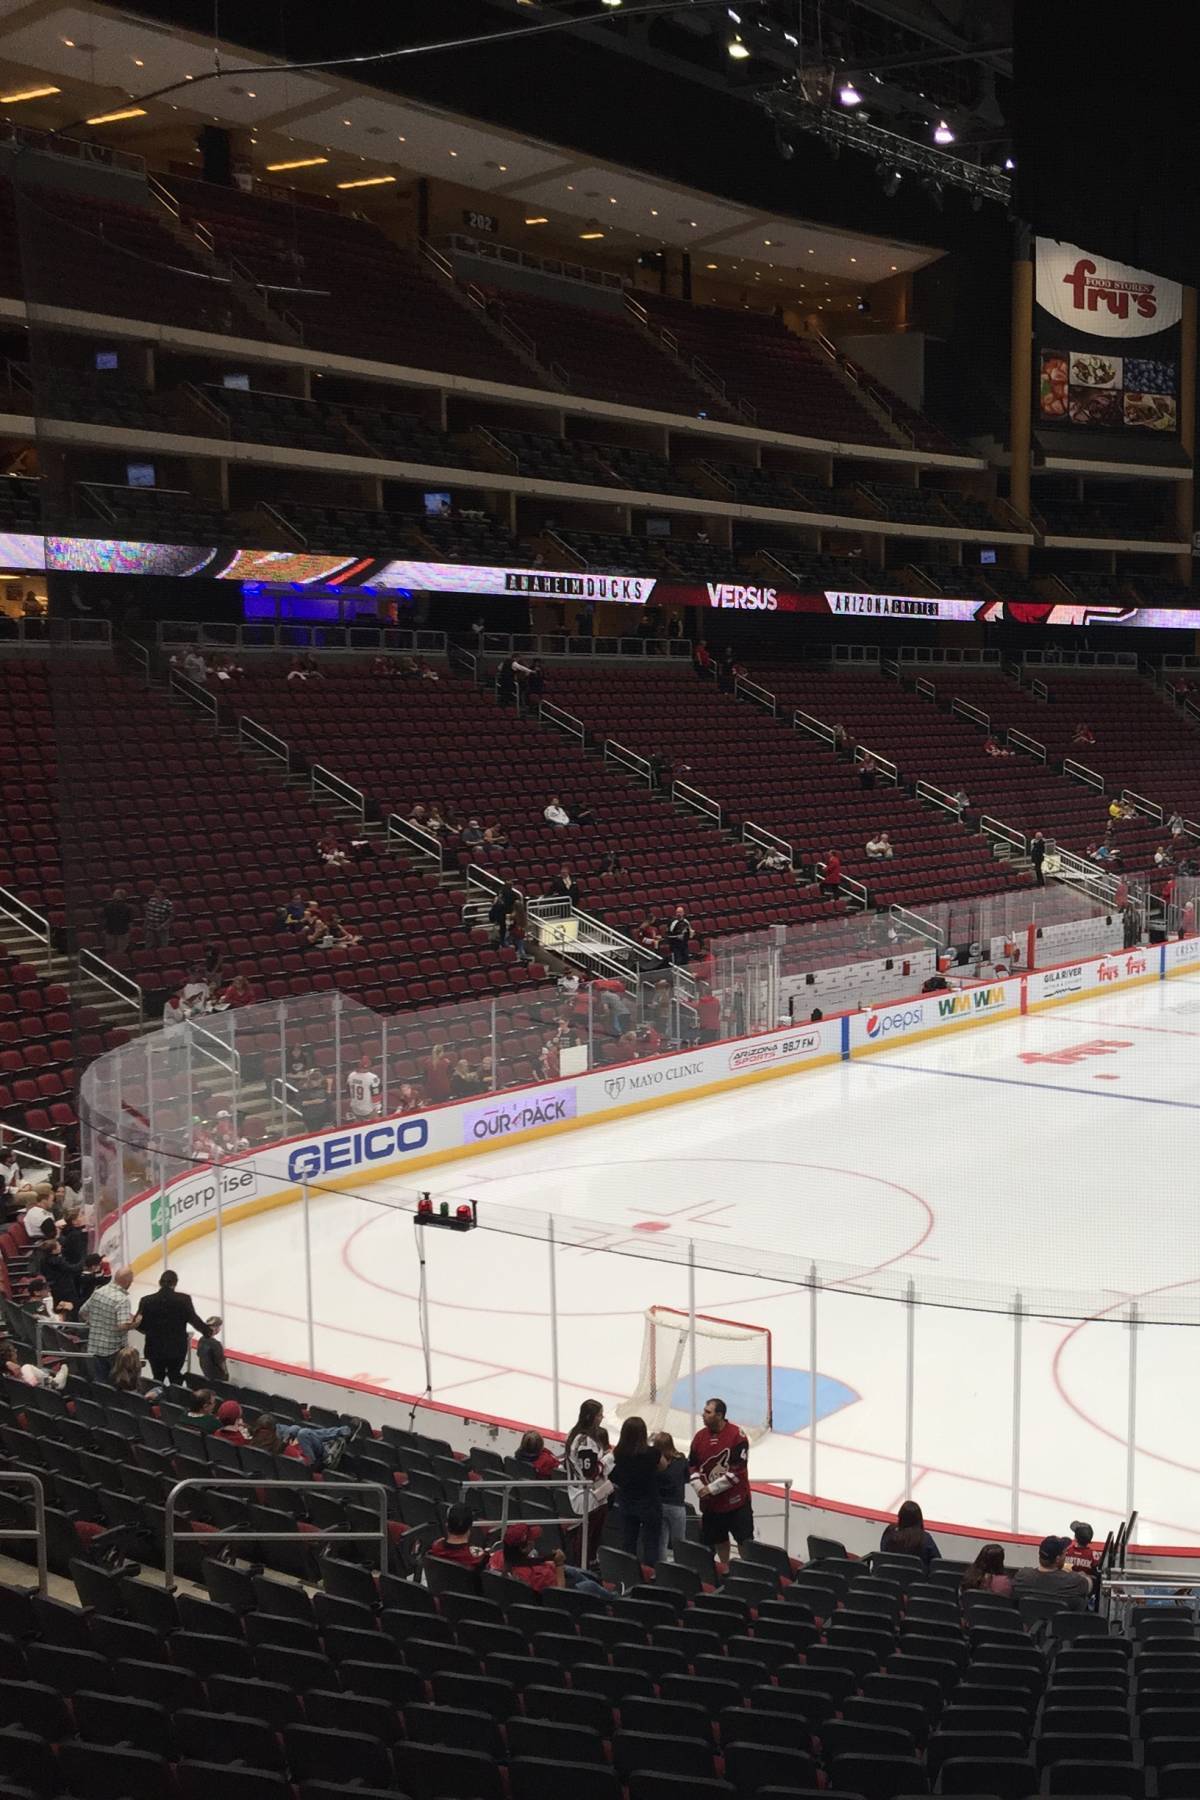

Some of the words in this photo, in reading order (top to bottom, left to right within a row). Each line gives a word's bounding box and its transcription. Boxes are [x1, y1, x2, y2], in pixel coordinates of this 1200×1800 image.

[469, 212, 492, 231] 202
[1063, 259, 1156, 319] fry's
[1085, 278, 1112, 288] FOOD
[508, 574, 581, 594] ANAHEIM
[587, 577, 642, 600] DUCKS
[706, 582, 777, 611] VERSUS
[835, 594, 890, 615] ARIZONA
[1043, 973, 1060, 983] GILA
[1061, 967, 1083, 979] RIVER
[938, 993, 972, 1017] WM
[974, 986, 1005, 1008] WM
[881, 1005, 924, 1036] pepsi
[733, 1044, 778, 1060] ARIZONA
[802, 1036, 815, 1048] FM
[734, 1053, 776, 1066] SPORTS
[629, 1071, 664, 1090] MAYO
[665, 1062, 705, 1081] CLINIC
[473, 1113, 511, 1138] OUR
[522, 1099, 566, 1128] PACK
[288, 1118, 428, 1182] GEICO
